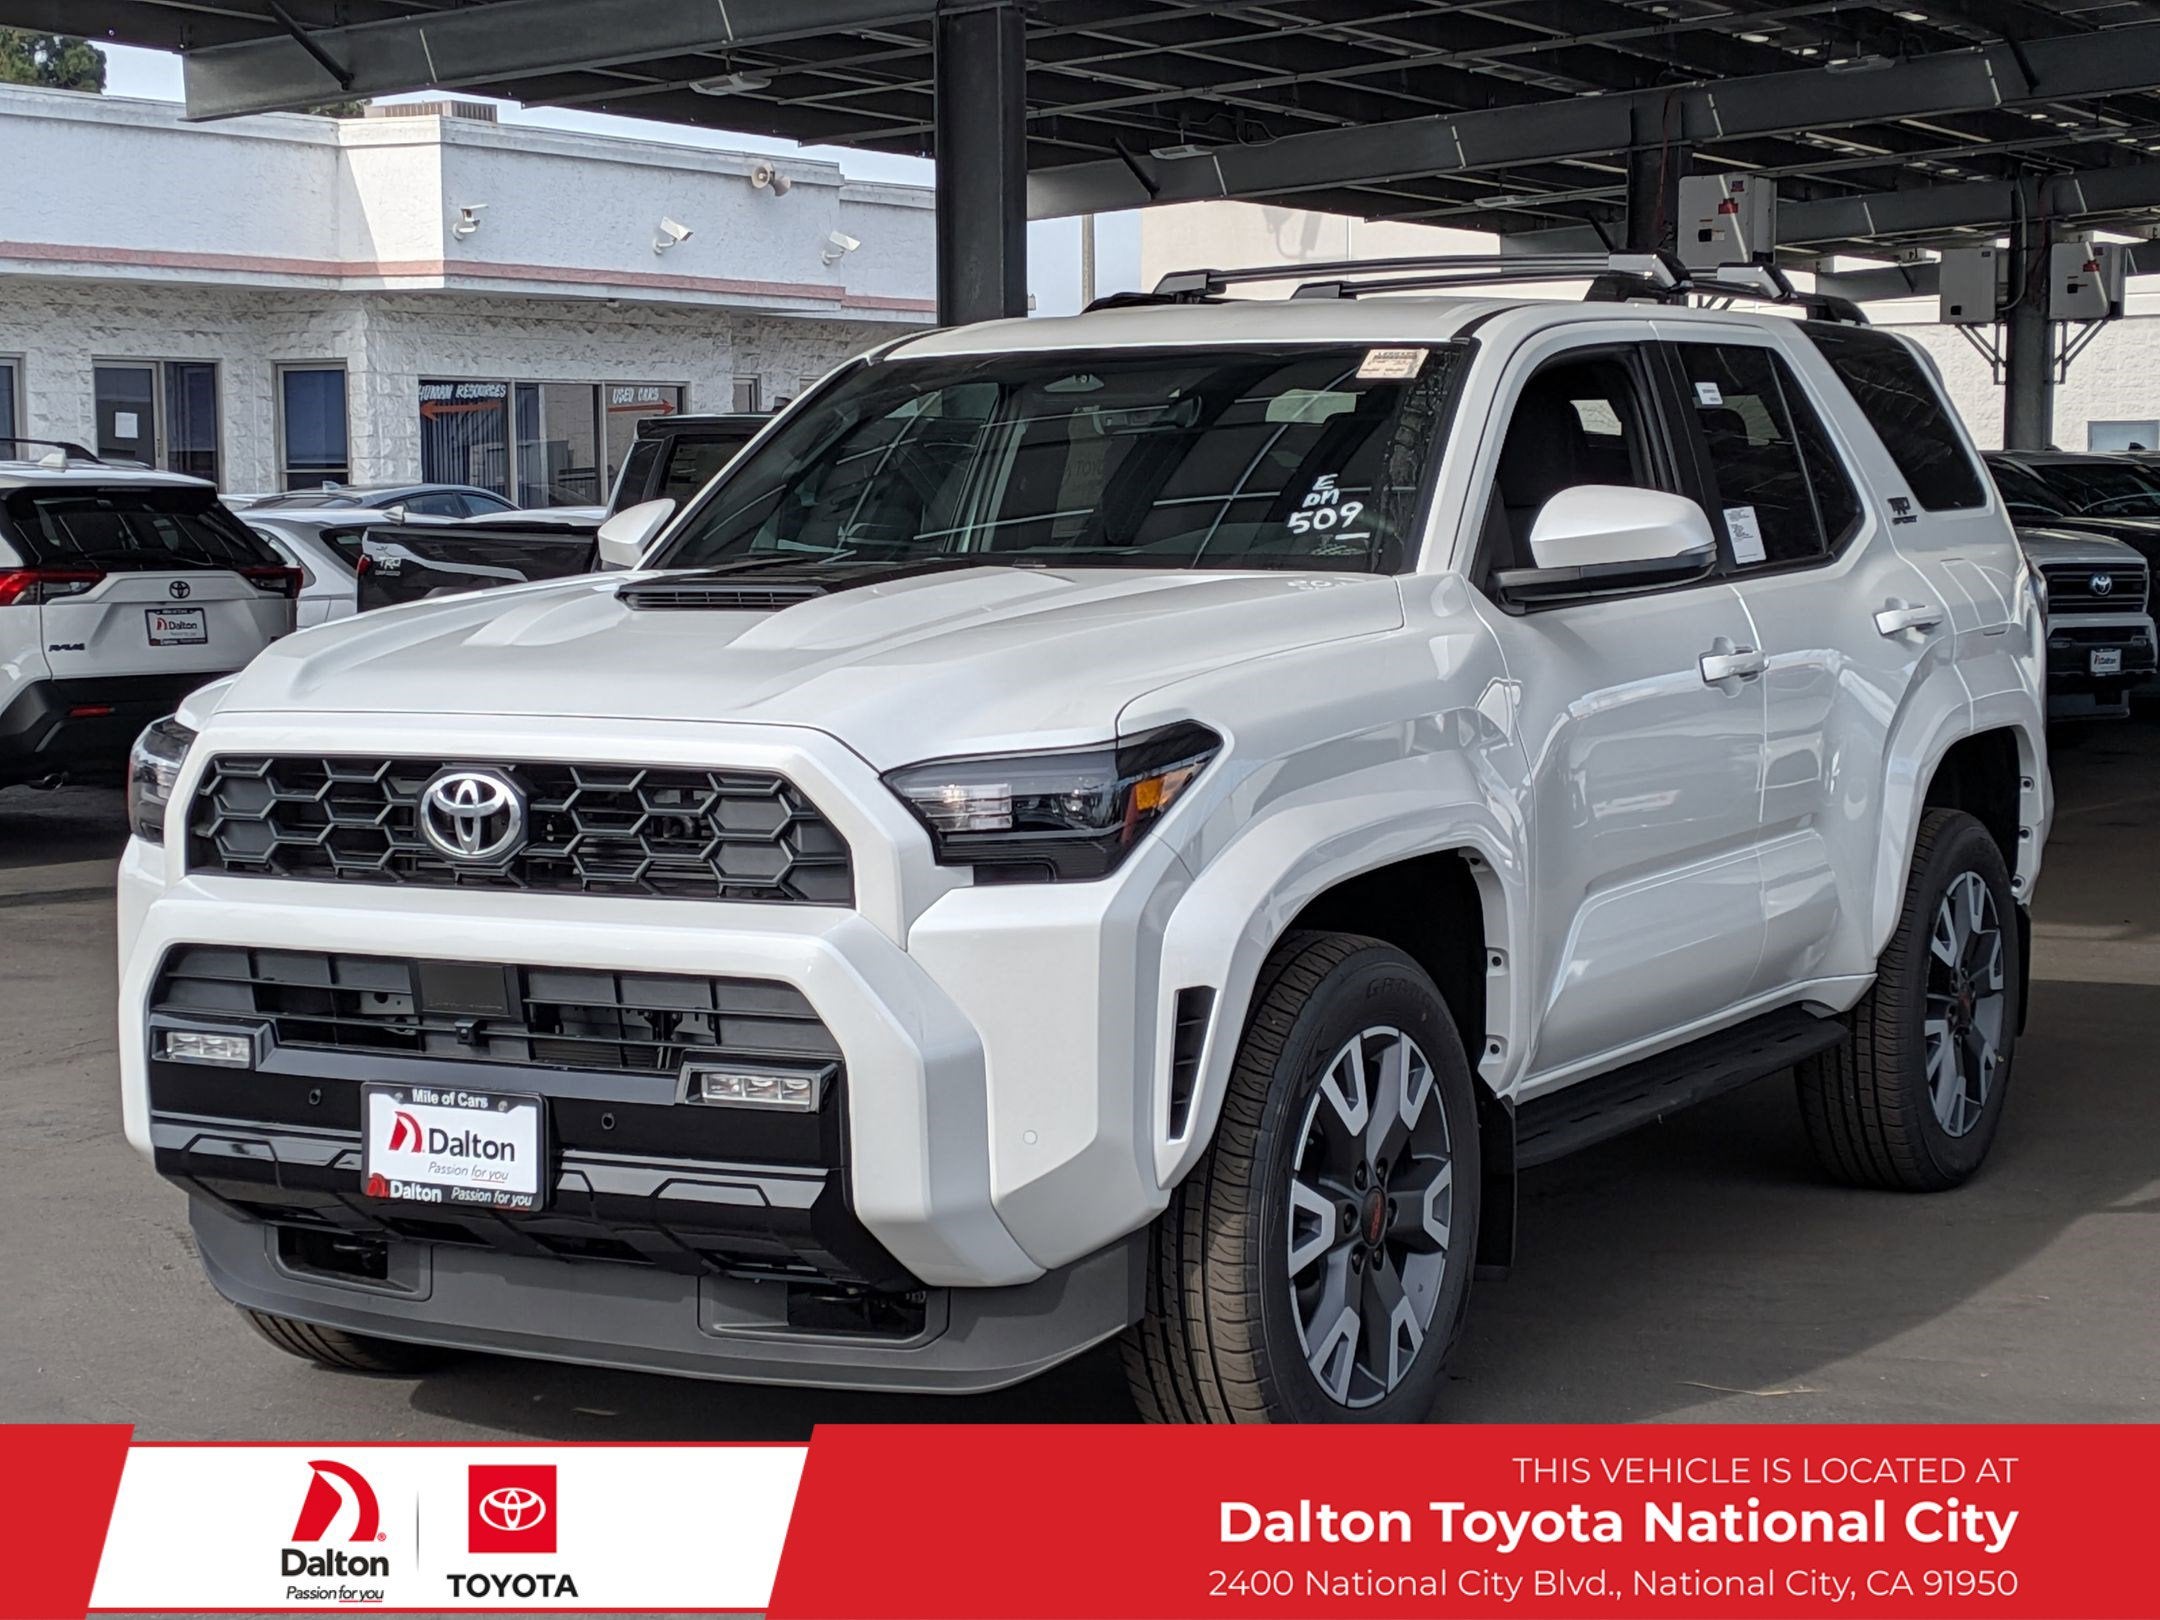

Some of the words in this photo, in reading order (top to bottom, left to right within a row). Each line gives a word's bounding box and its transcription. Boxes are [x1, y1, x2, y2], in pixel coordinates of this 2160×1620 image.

[418, 384, 453, 401] HUMAN
[456, 383, 507, 399] RESOURCES
[612, 387, 634, 404] USED
[638, 387, 659, 402] CARS
[1312, 473, 1338, 491] E
[1287, 501, 1364, 534] 509
[168, 620, 198, 630] Dalton
[412, 1088, 438, 1104] Mile
[441, 1091, 454, 1105] of
[457, 1093, 488, 1108] Cars
[428, 1127, 515, 1161] Dalton
[428, 1161, 468, 1176] Passion
[470, 1164, 487, 1180] for
[488, 1170, 509, 1181] you
[390, 1180, 442, 1203] Dalton
[451, 1187, 491, 1204] Passion
[493, 1190, 510, 1206] for
[510, 1194, 532, 1207] you
